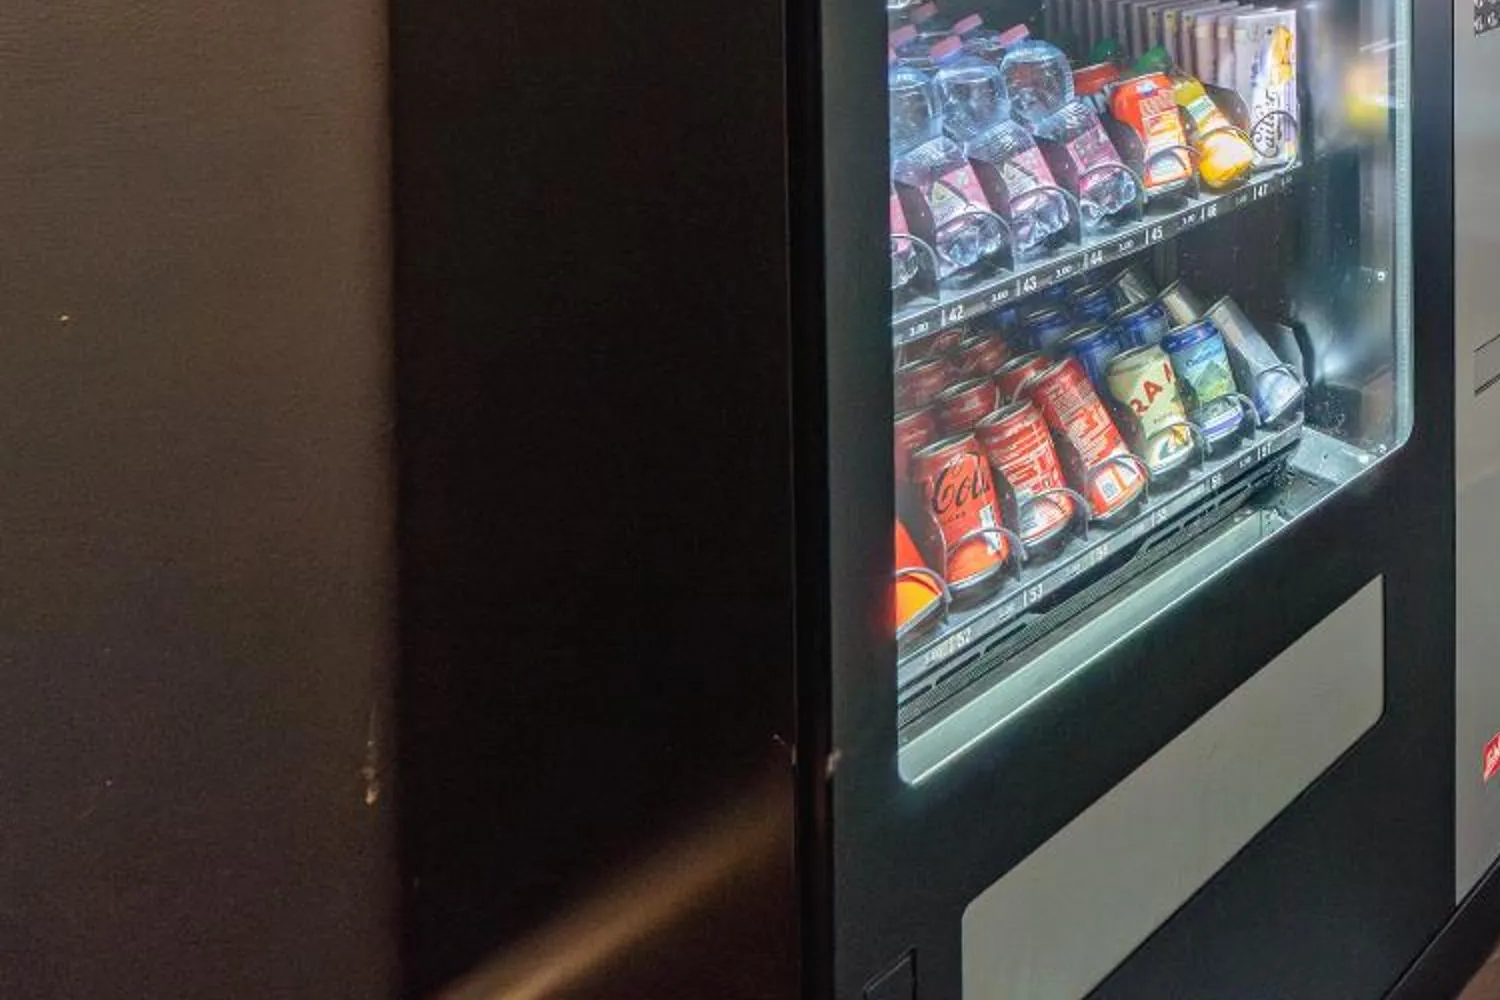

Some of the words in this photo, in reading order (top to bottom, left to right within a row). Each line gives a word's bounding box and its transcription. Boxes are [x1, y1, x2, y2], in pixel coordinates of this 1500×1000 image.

[1152, 226, 1163, 241] 45
[1024, 275, 1037, 292] 43
[949, 305, 964, 321] 42
[1030, 583, 1043, 602] 53
